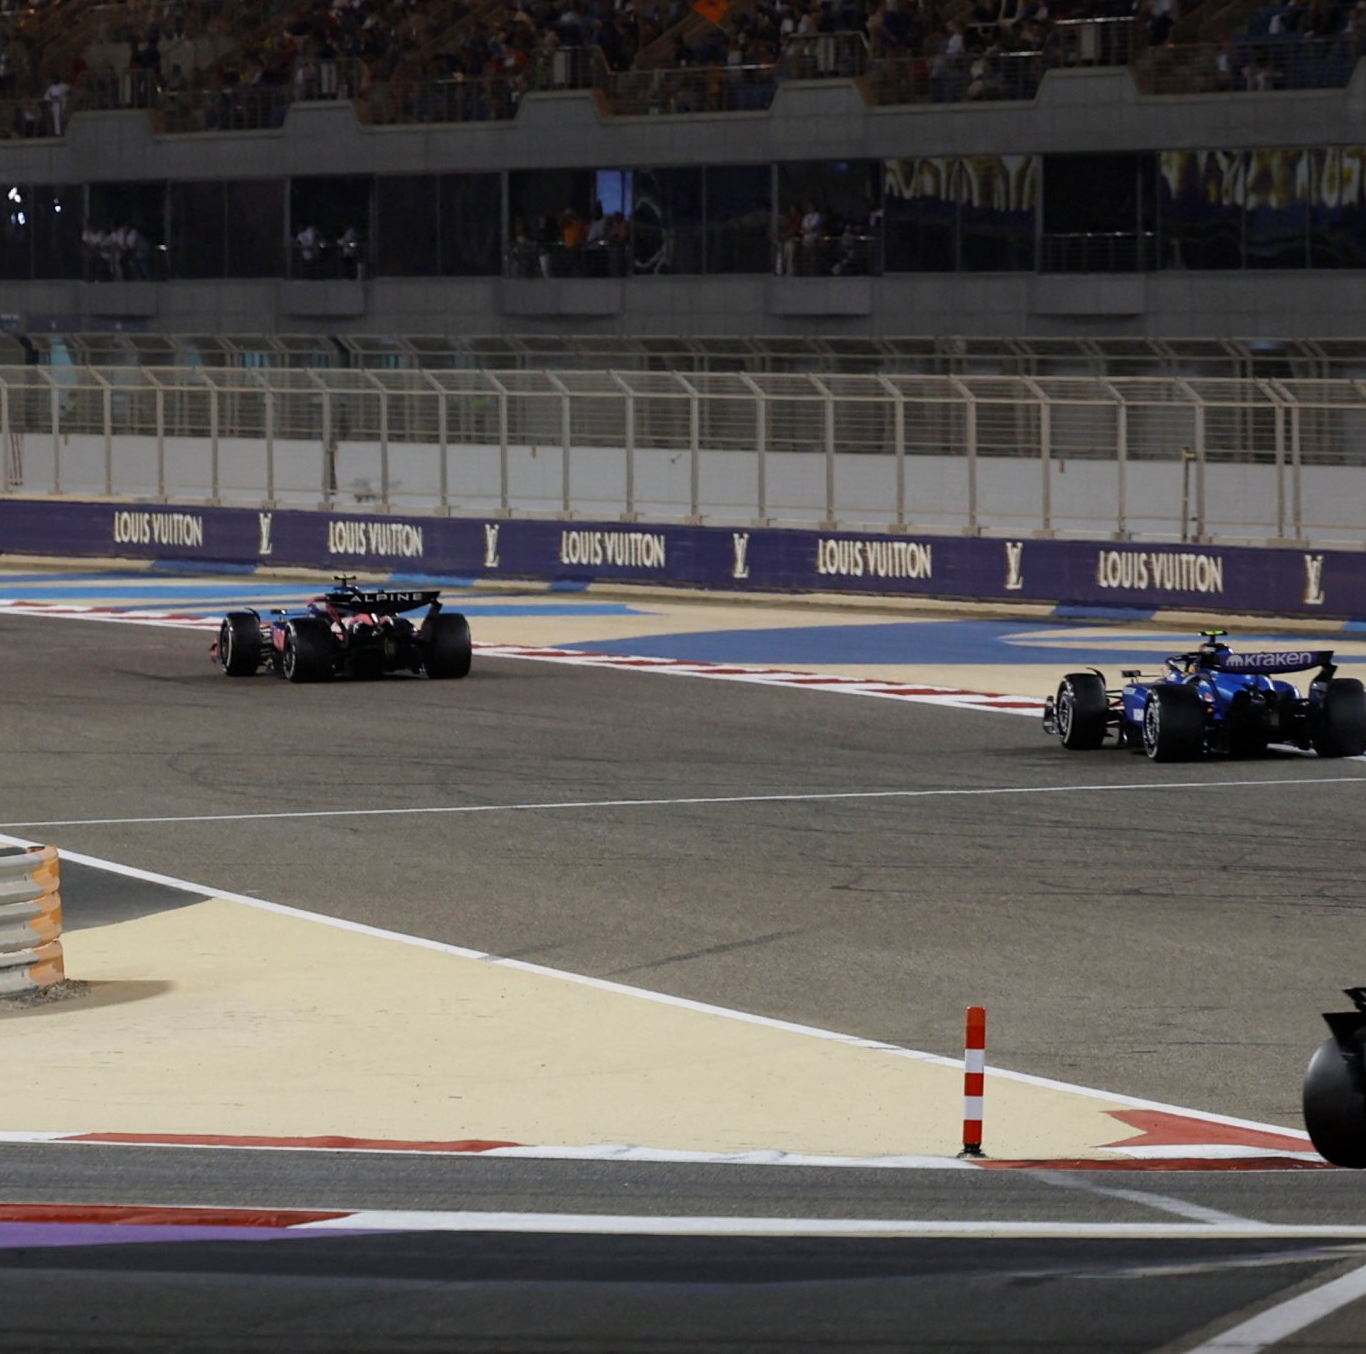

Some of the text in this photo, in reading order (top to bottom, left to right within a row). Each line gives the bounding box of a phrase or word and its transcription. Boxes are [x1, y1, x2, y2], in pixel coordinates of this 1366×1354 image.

[114, 511, 203, 547] LOUIS VUITTON
[328, 520, 423, 557] LOUIS VUITTON
[560, 530, 666, 568] LOUIS VUITTON
[817, 538, 932, 579] LOUIS VUITTON
[1098, 550, 1223, 593] LOUIS VUITTON
[350, 592, 422, 603] ALPINE
